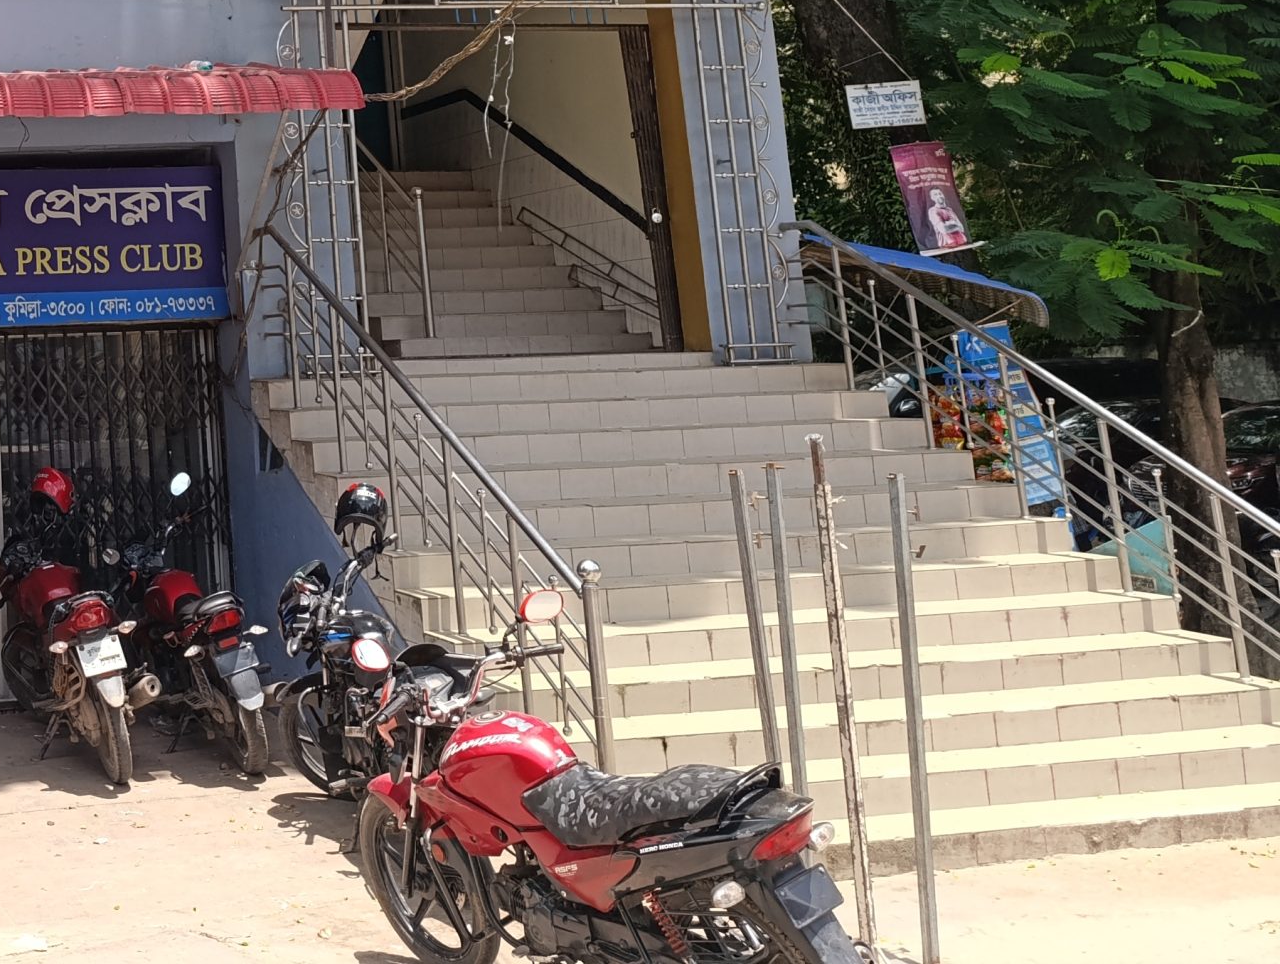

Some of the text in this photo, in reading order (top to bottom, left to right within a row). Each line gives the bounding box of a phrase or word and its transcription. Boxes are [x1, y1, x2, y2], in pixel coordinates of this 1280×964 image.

[24, 182, 212, 227] প্রেসক্লাব
[14, 245, 110, 275] PRESS
[120, 243, 203, 272] CLUB
[4, 296, 85, 323] কুমিল্লা-৩৫০০
[99, 297, 131, 315] ফোন:
